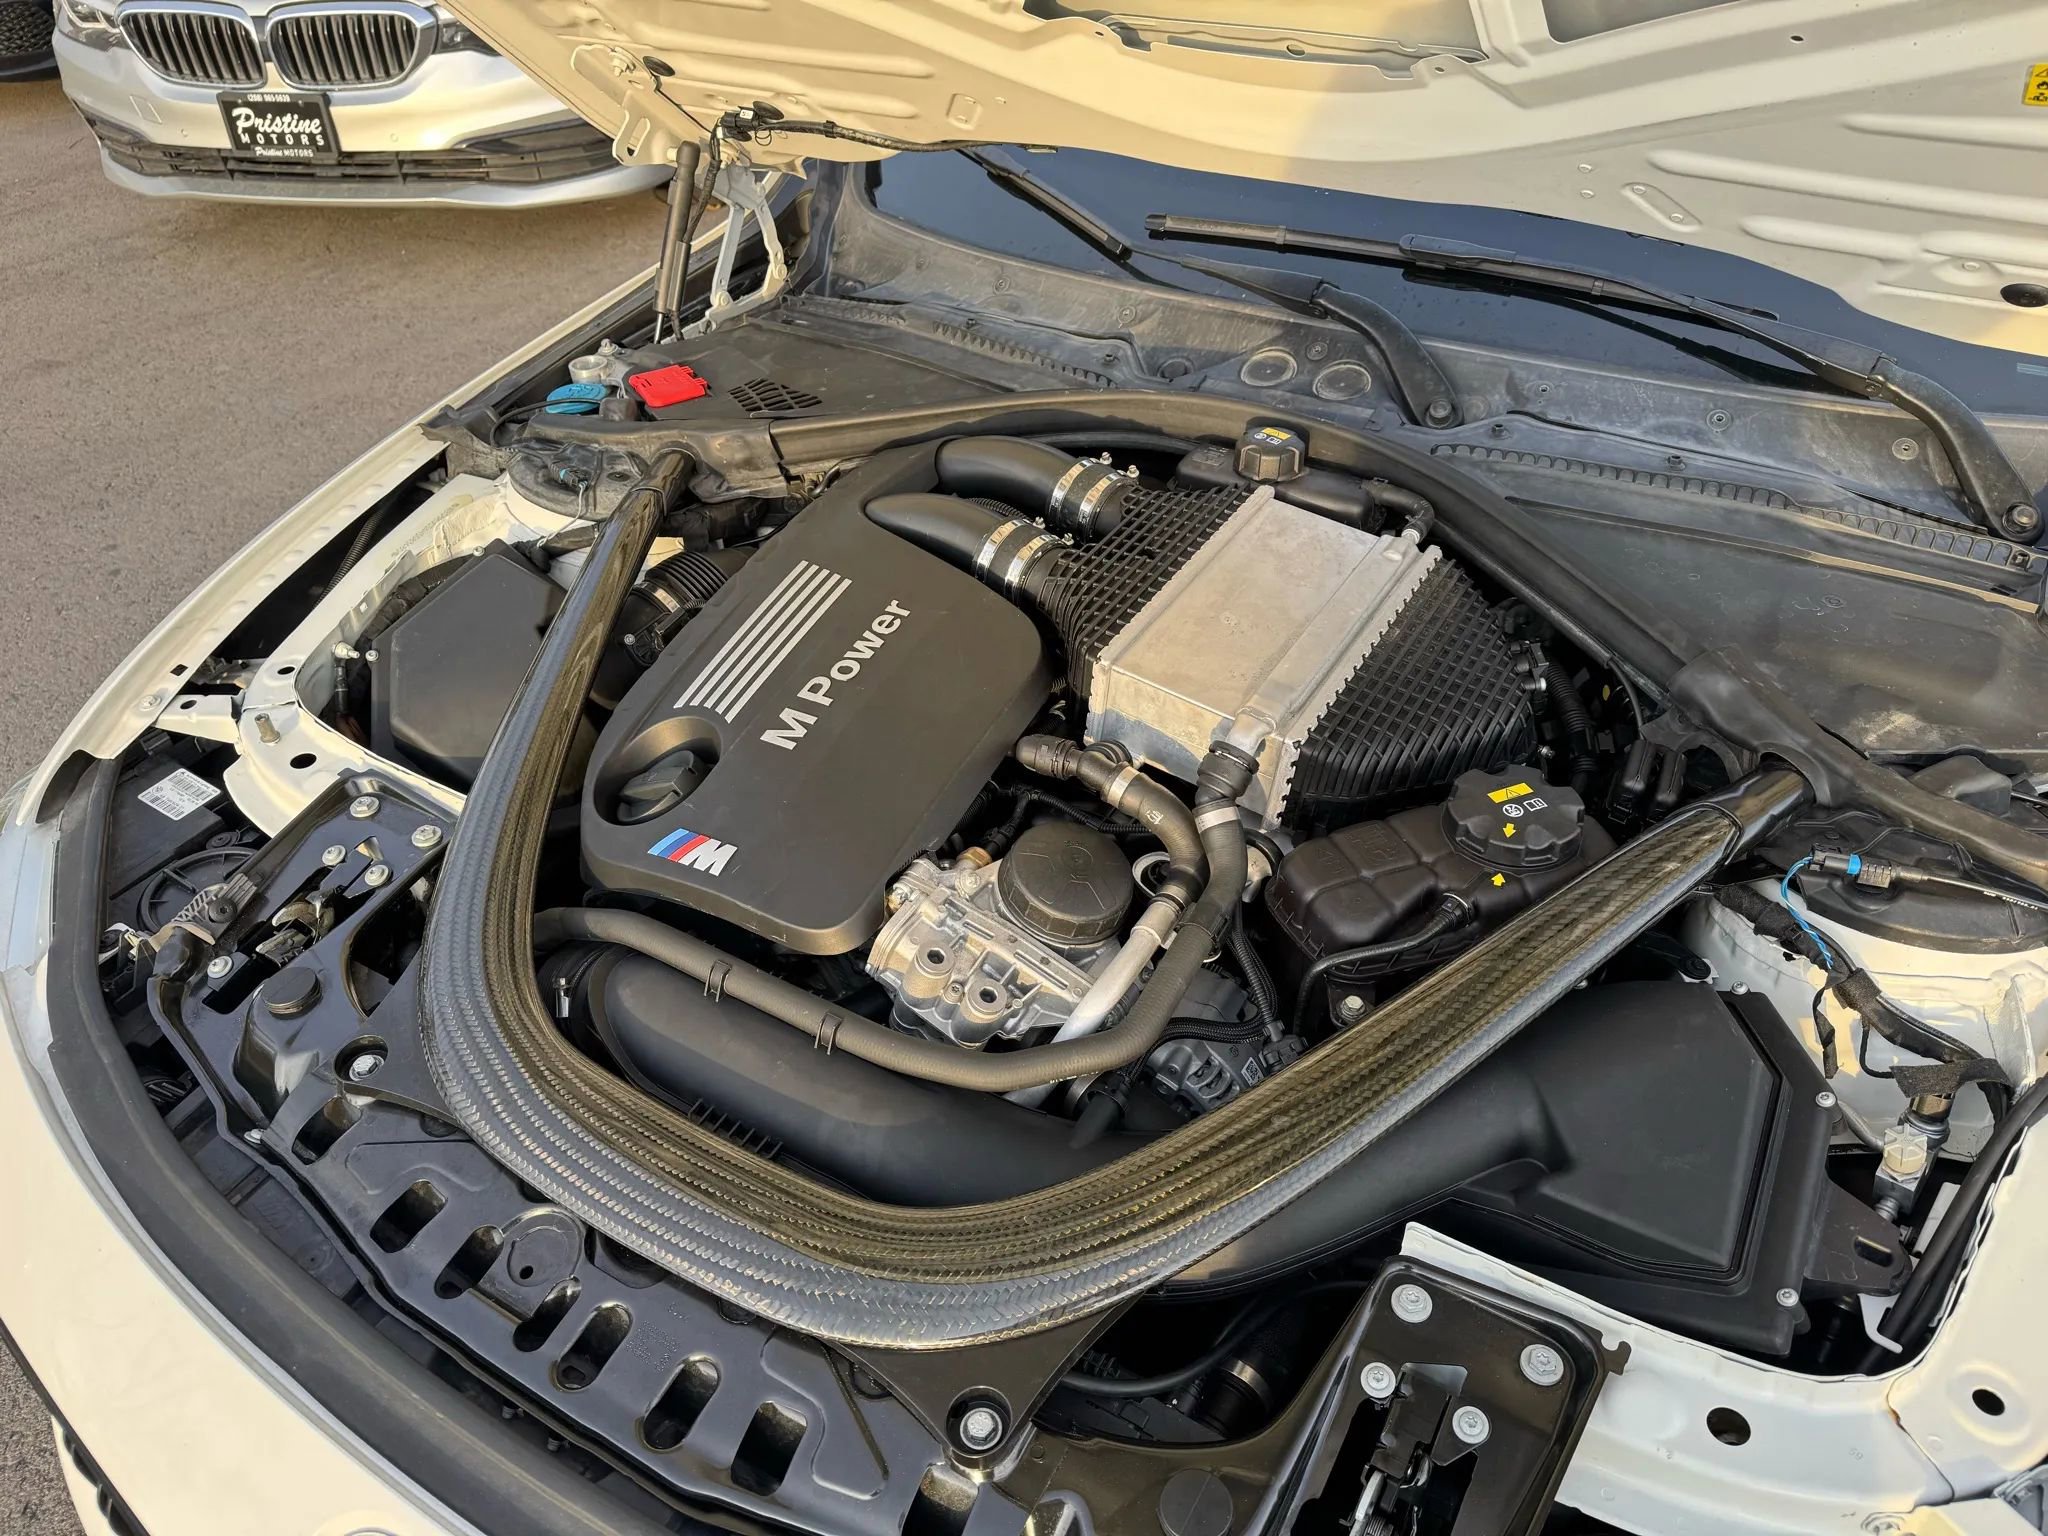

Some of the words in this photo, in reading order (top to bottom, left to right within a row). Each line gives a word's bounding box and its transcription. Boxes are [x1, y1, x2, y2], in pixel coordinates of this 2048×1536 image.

[232, 107, 322, 134] Pristine
[240, 133, 325, 146] MOTORS
[283, 149, 314, 158] MOTORS
[759, 707, 818, 750] M
[797, 599, 911, 706] Power
